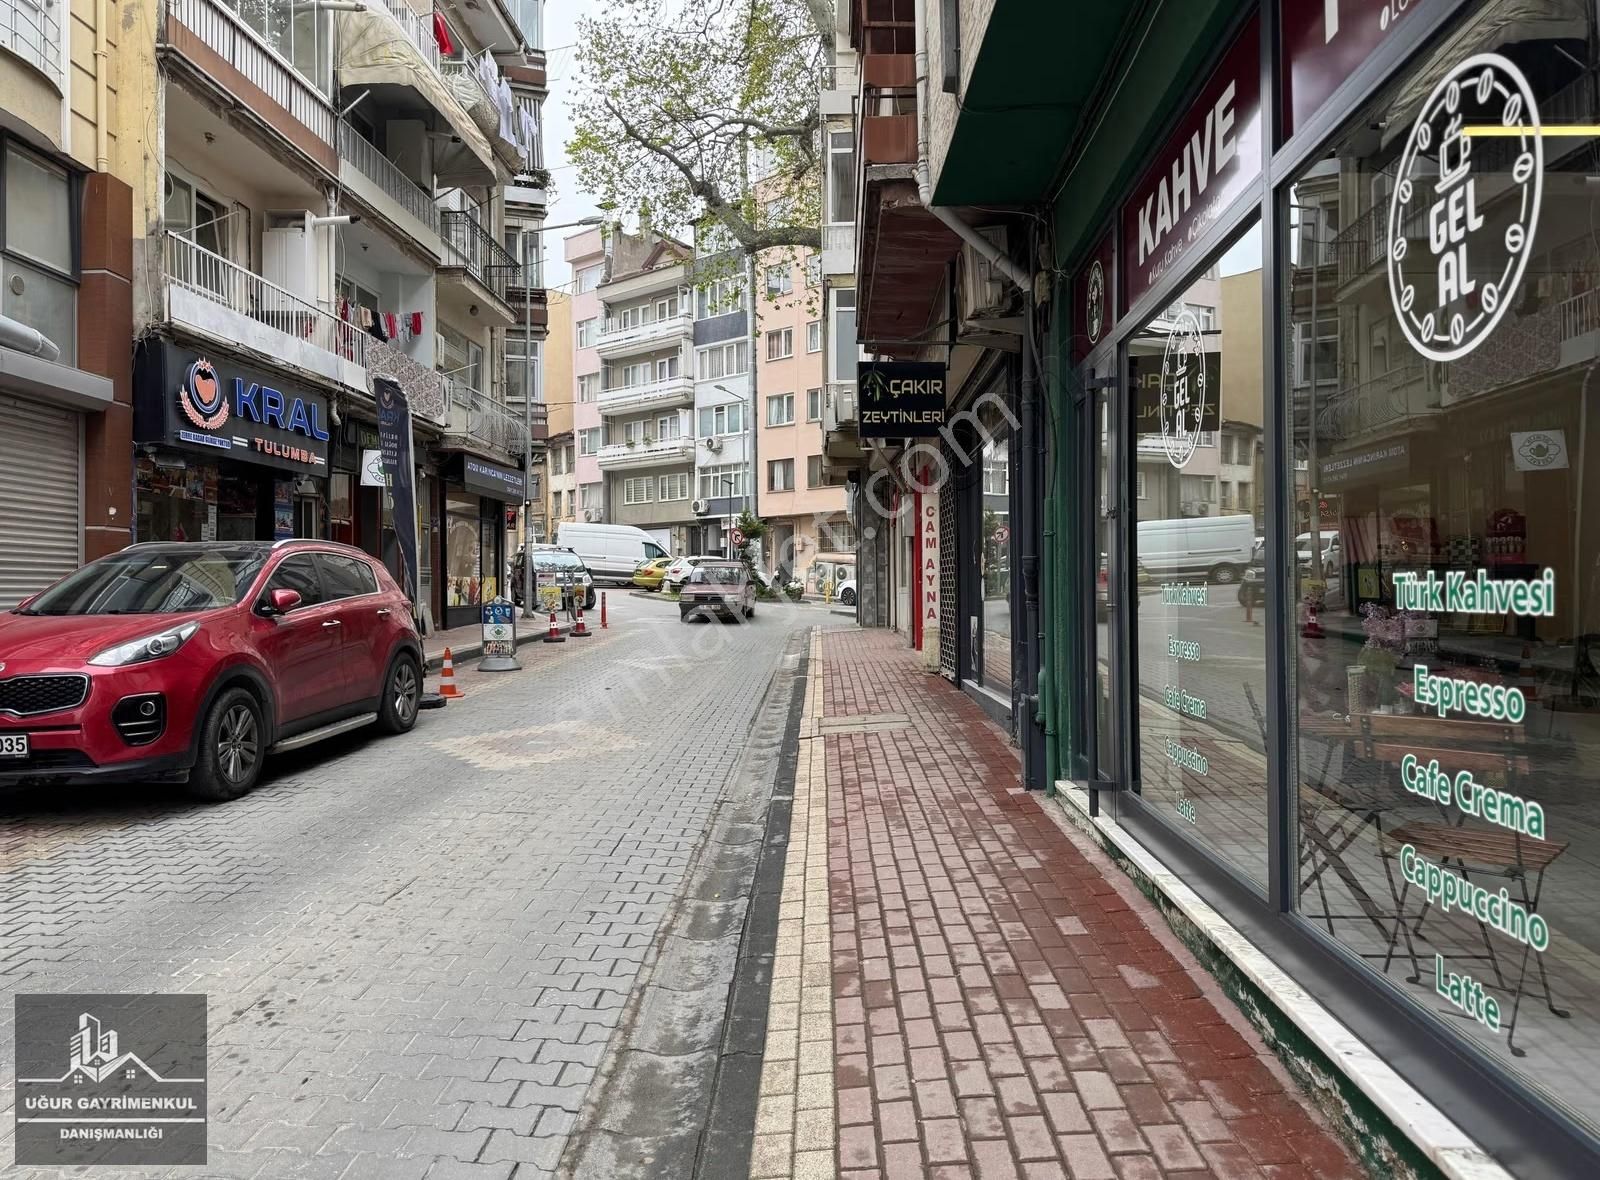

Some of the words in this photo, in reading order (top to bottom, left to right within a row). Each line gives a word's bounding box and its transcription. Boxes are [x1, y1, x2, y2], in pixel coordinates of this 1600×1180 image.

[1138, 79, 1236, 267] KAHVE
[1429, 178, 1485, 254] GEL
[1164, 239, 1182, 266] Kahve
[1438, 243, 1477, 307] AL
[234, 377, 330, 442] KRAL
[889, 379, 943, 398] ÇAKIR
[1173, 375, 1190, 410] GEL
[862, 408, 945, 424] ZEYTİNLERİ
[1176, 408, 1188, 439] AL
[255, 437, 317, 465] TULUMBA
[925, 506, 937, 549] CAM
[925, 557, 937, 620] AYNA
[1160, 582, 1177, 605] Türk
[1176, 581, 1208, 606] Kahvesi
[1392, 570, 1444, 612] Türk
[1446, 567, 1555, 617] Kahvesi
[1167, 634, 1201, 662] Espresso
[1163, 684, 1181, 709] Cafe
[1181, 689, 1207, 720] Crema
[1413, 664, 1526, 724] Espresso
[1164, 735, 1209, 776] Cappuccino
[1400, 753, 1451, 805] Cafe
[1455, 770, 1546, 841] Crema
[1399, 843, 1549, 953] Cappuccino
[1434, 953, 1501, 1034] Latte
